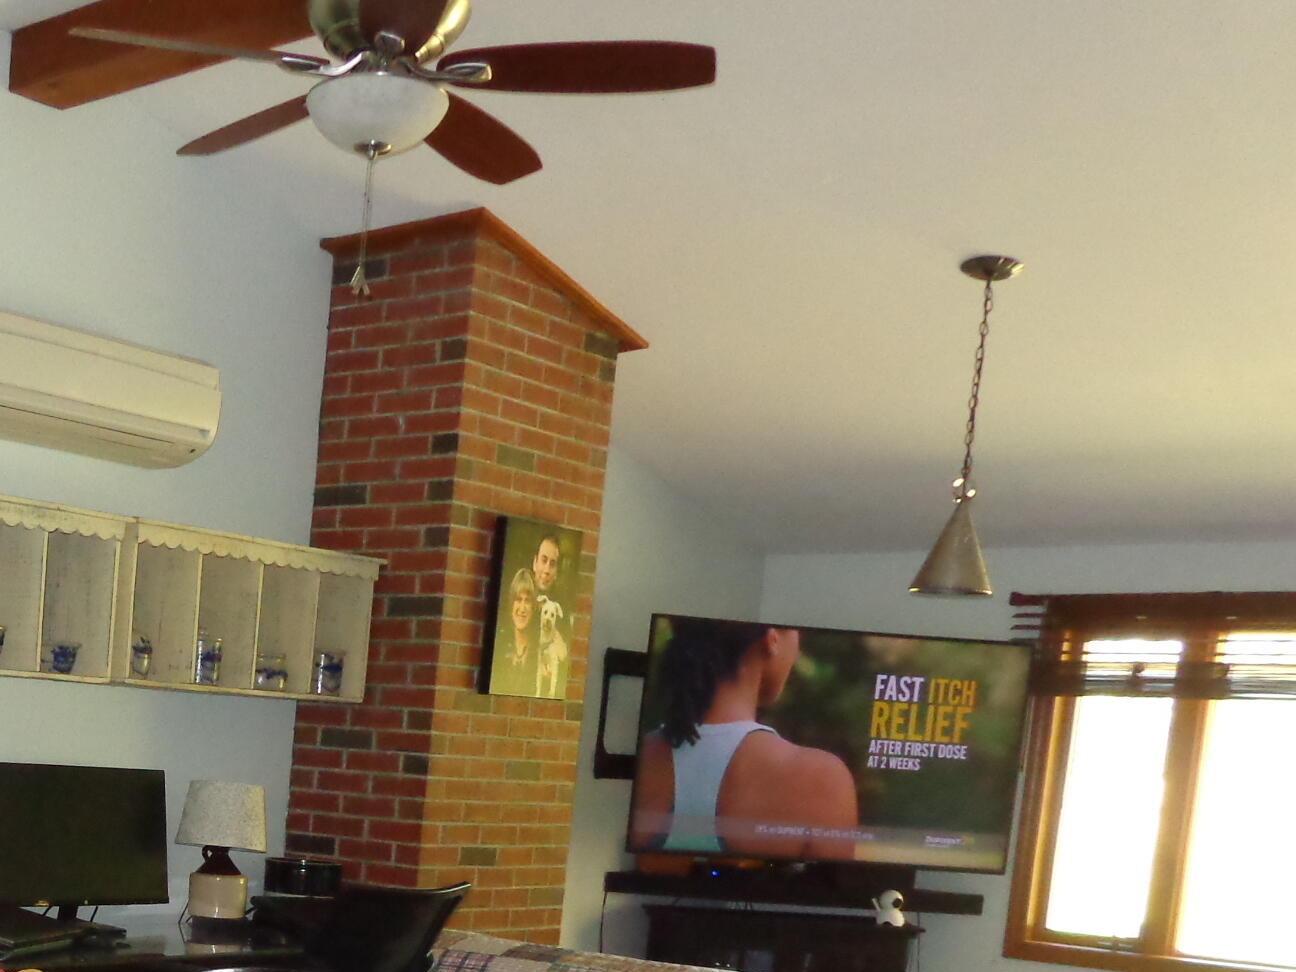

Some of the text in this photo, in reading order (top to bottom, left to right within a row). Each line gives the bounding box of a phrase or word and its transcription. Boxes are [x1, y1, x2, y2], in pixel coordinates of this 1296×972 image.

[874, 674, 977, 706] FAST ITCH
[870, 701, 974, 743] RELIEF
[868, 739, 968, 760] AFTER FIRST DOSE
[867, 755, 921, 771] AT 2 WEEKS
